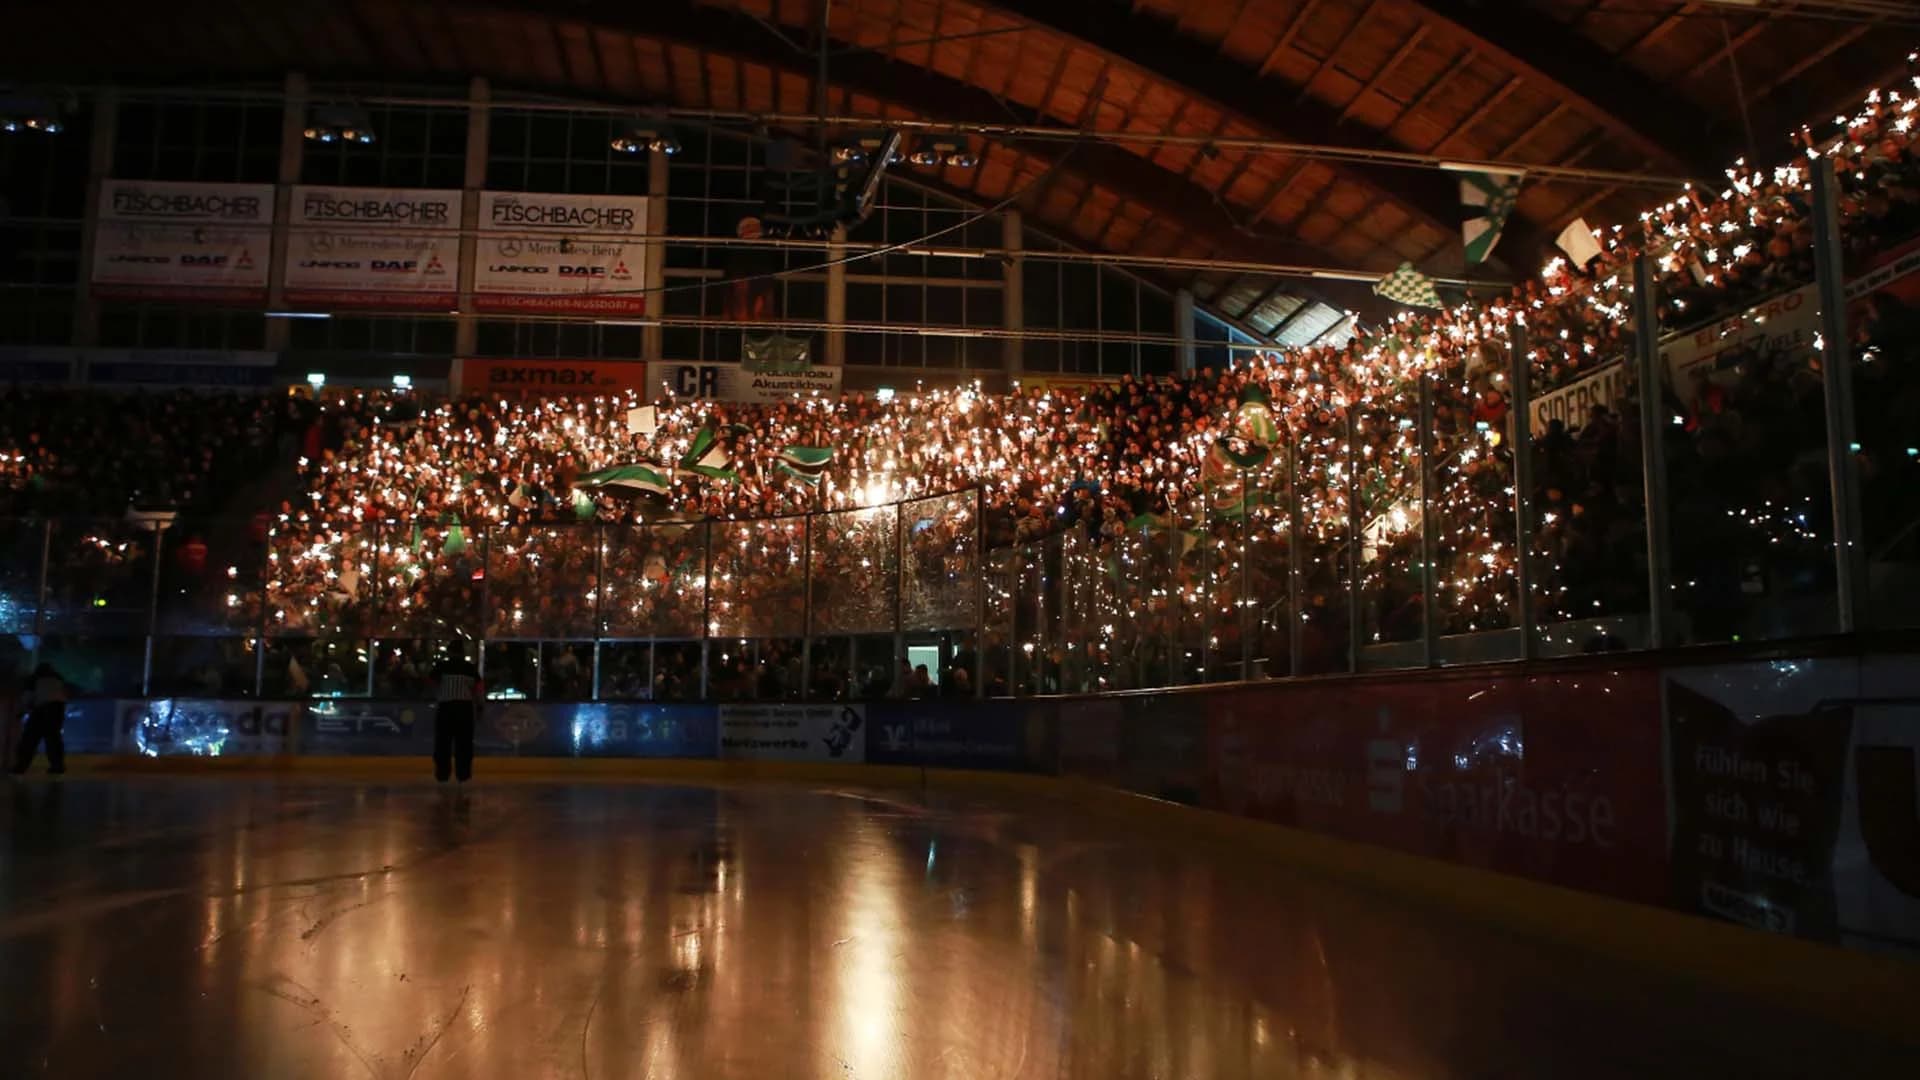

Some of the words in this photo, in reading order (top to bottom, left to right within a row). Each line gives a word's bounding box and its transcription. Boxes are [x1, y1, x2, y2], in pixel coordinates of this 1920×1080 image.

[114, 192, 260, 216] FISCHBACHER
[304, 199, 448, 220] FISCHBACHER
[492, 204, 634, 226] FISCHBACHER
[528, 242, 623, 257] Mercdes-Benz
[181, 255, 228, 264] DAF
[371, 260, 417, 270] DAF
[559, 265, 606, 275] DAF
[490, 367, 595, 385] axmax
[752, 378, 833, 391] Akustikbau
[1418, 766, 1616, 847] Sparkasse
[1704, 786, 1749, 824] sich
